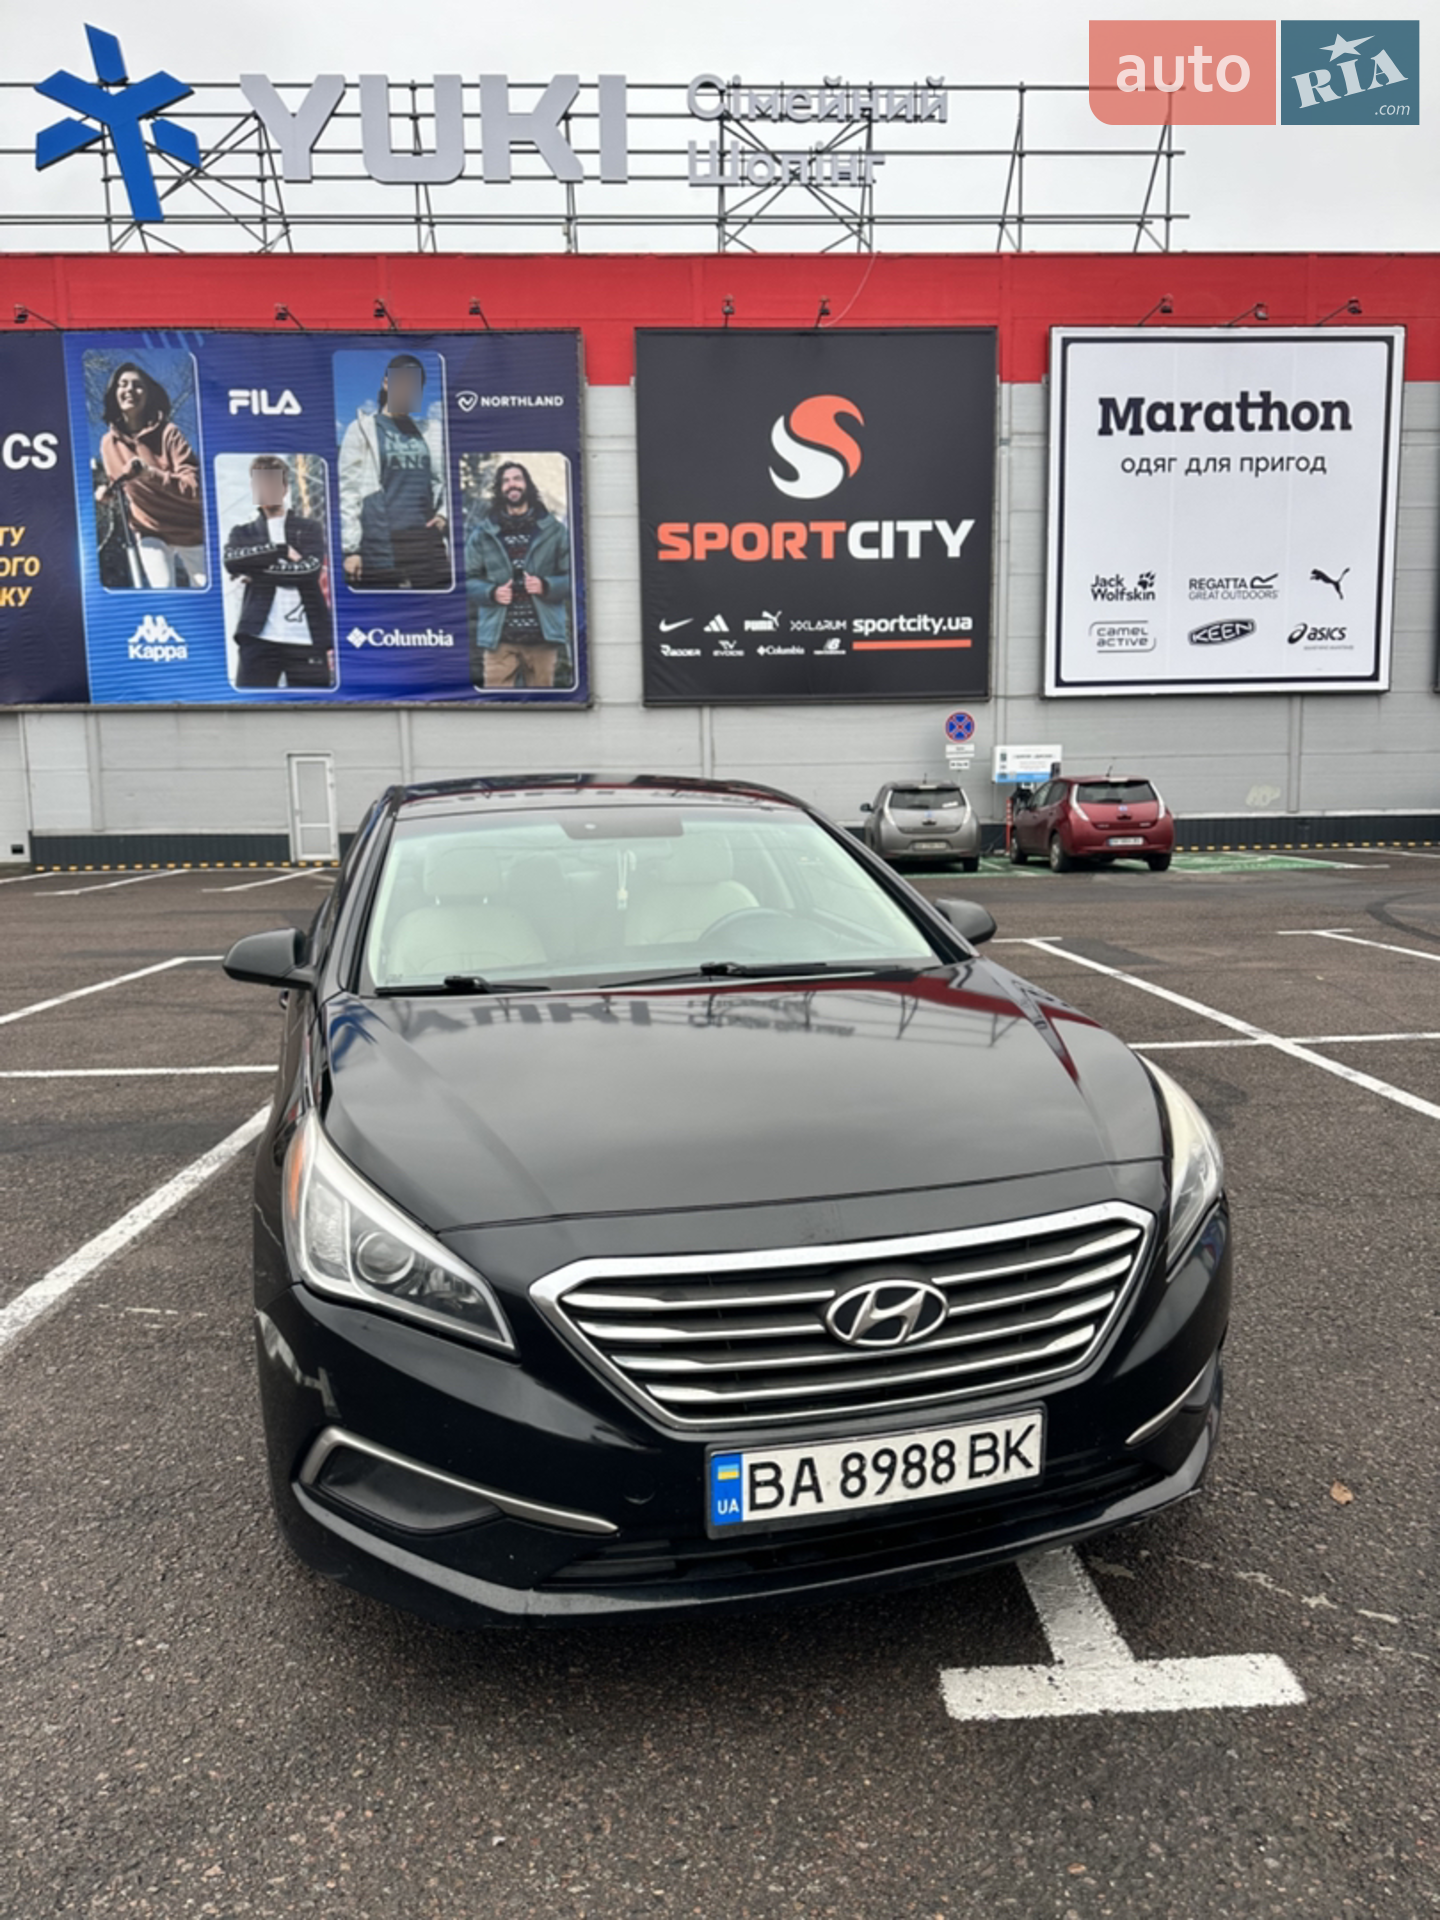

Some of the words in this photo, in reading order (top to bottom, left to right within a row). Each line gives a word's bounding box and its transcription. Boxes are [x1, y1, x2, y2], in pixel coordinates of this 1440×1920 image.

[687, 73, 948, 124] Сімейний
[240, 73, 628, 184] YUKI
[687, 140, 885, 187] Шопінг
[228, 389, 302, 415] FILA
[481, 395, 564, 407] NORTHLAND
[1098, 390, 1352, 436] Marathon
[1121, 457, 1177, 476] одяг
[1185, 457, 1231, 476] для
[1240, 456, 1327, 478] пригод
[657, 519, 976, 561] SPORTCITY
[1091, 574, 1124, 588] Jack
[1188, 578, 1248, 590] REGATTA
[1091, 588, 1156, 601] Wolfskin
[1188, 590, 1219, 600] GREAT
[1221, 590, 1278, 600] OUTDOORS
[852, 614, 973, 636] sportcity.ua
[1192, 622, 1252, 642] KEEN
[367, 629, 454, 648] Columbia
[128, 645, 188, 662] Kappa
[748, 1457, 824, 1512] BA
[839, 1438, 957, 1500] 8988
[967, 1423, 1036, 1480] BK
[717, 1498, 740, 1515] UA
